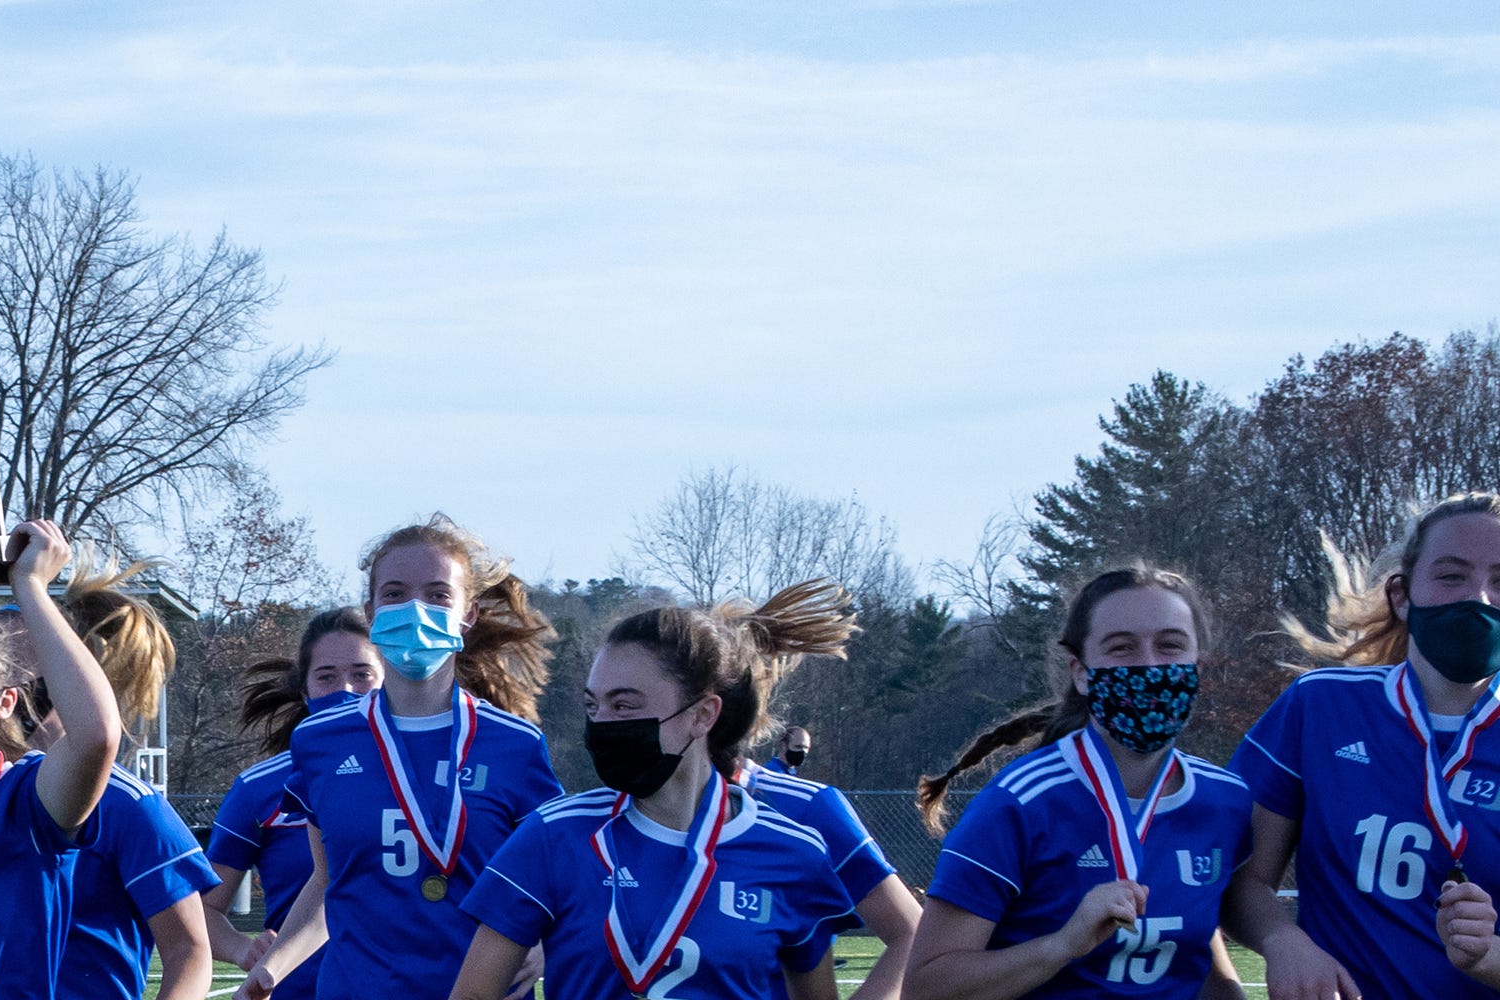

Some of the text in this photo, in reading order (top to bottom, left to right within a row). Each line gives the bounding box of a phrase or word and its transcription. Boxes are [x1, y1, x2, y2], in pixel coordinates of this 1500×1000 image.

[1334, 749, 1371, 764] adidas
[1467, 779, 1495, 798] 32
[381, 808, 420, 877] 5
[1193, 856, 1211, 876] 32
[1354, 813, 1433, 900] 16
[736, 890, 758, 911] 32
[1106, 915, 1184, 985] 15
